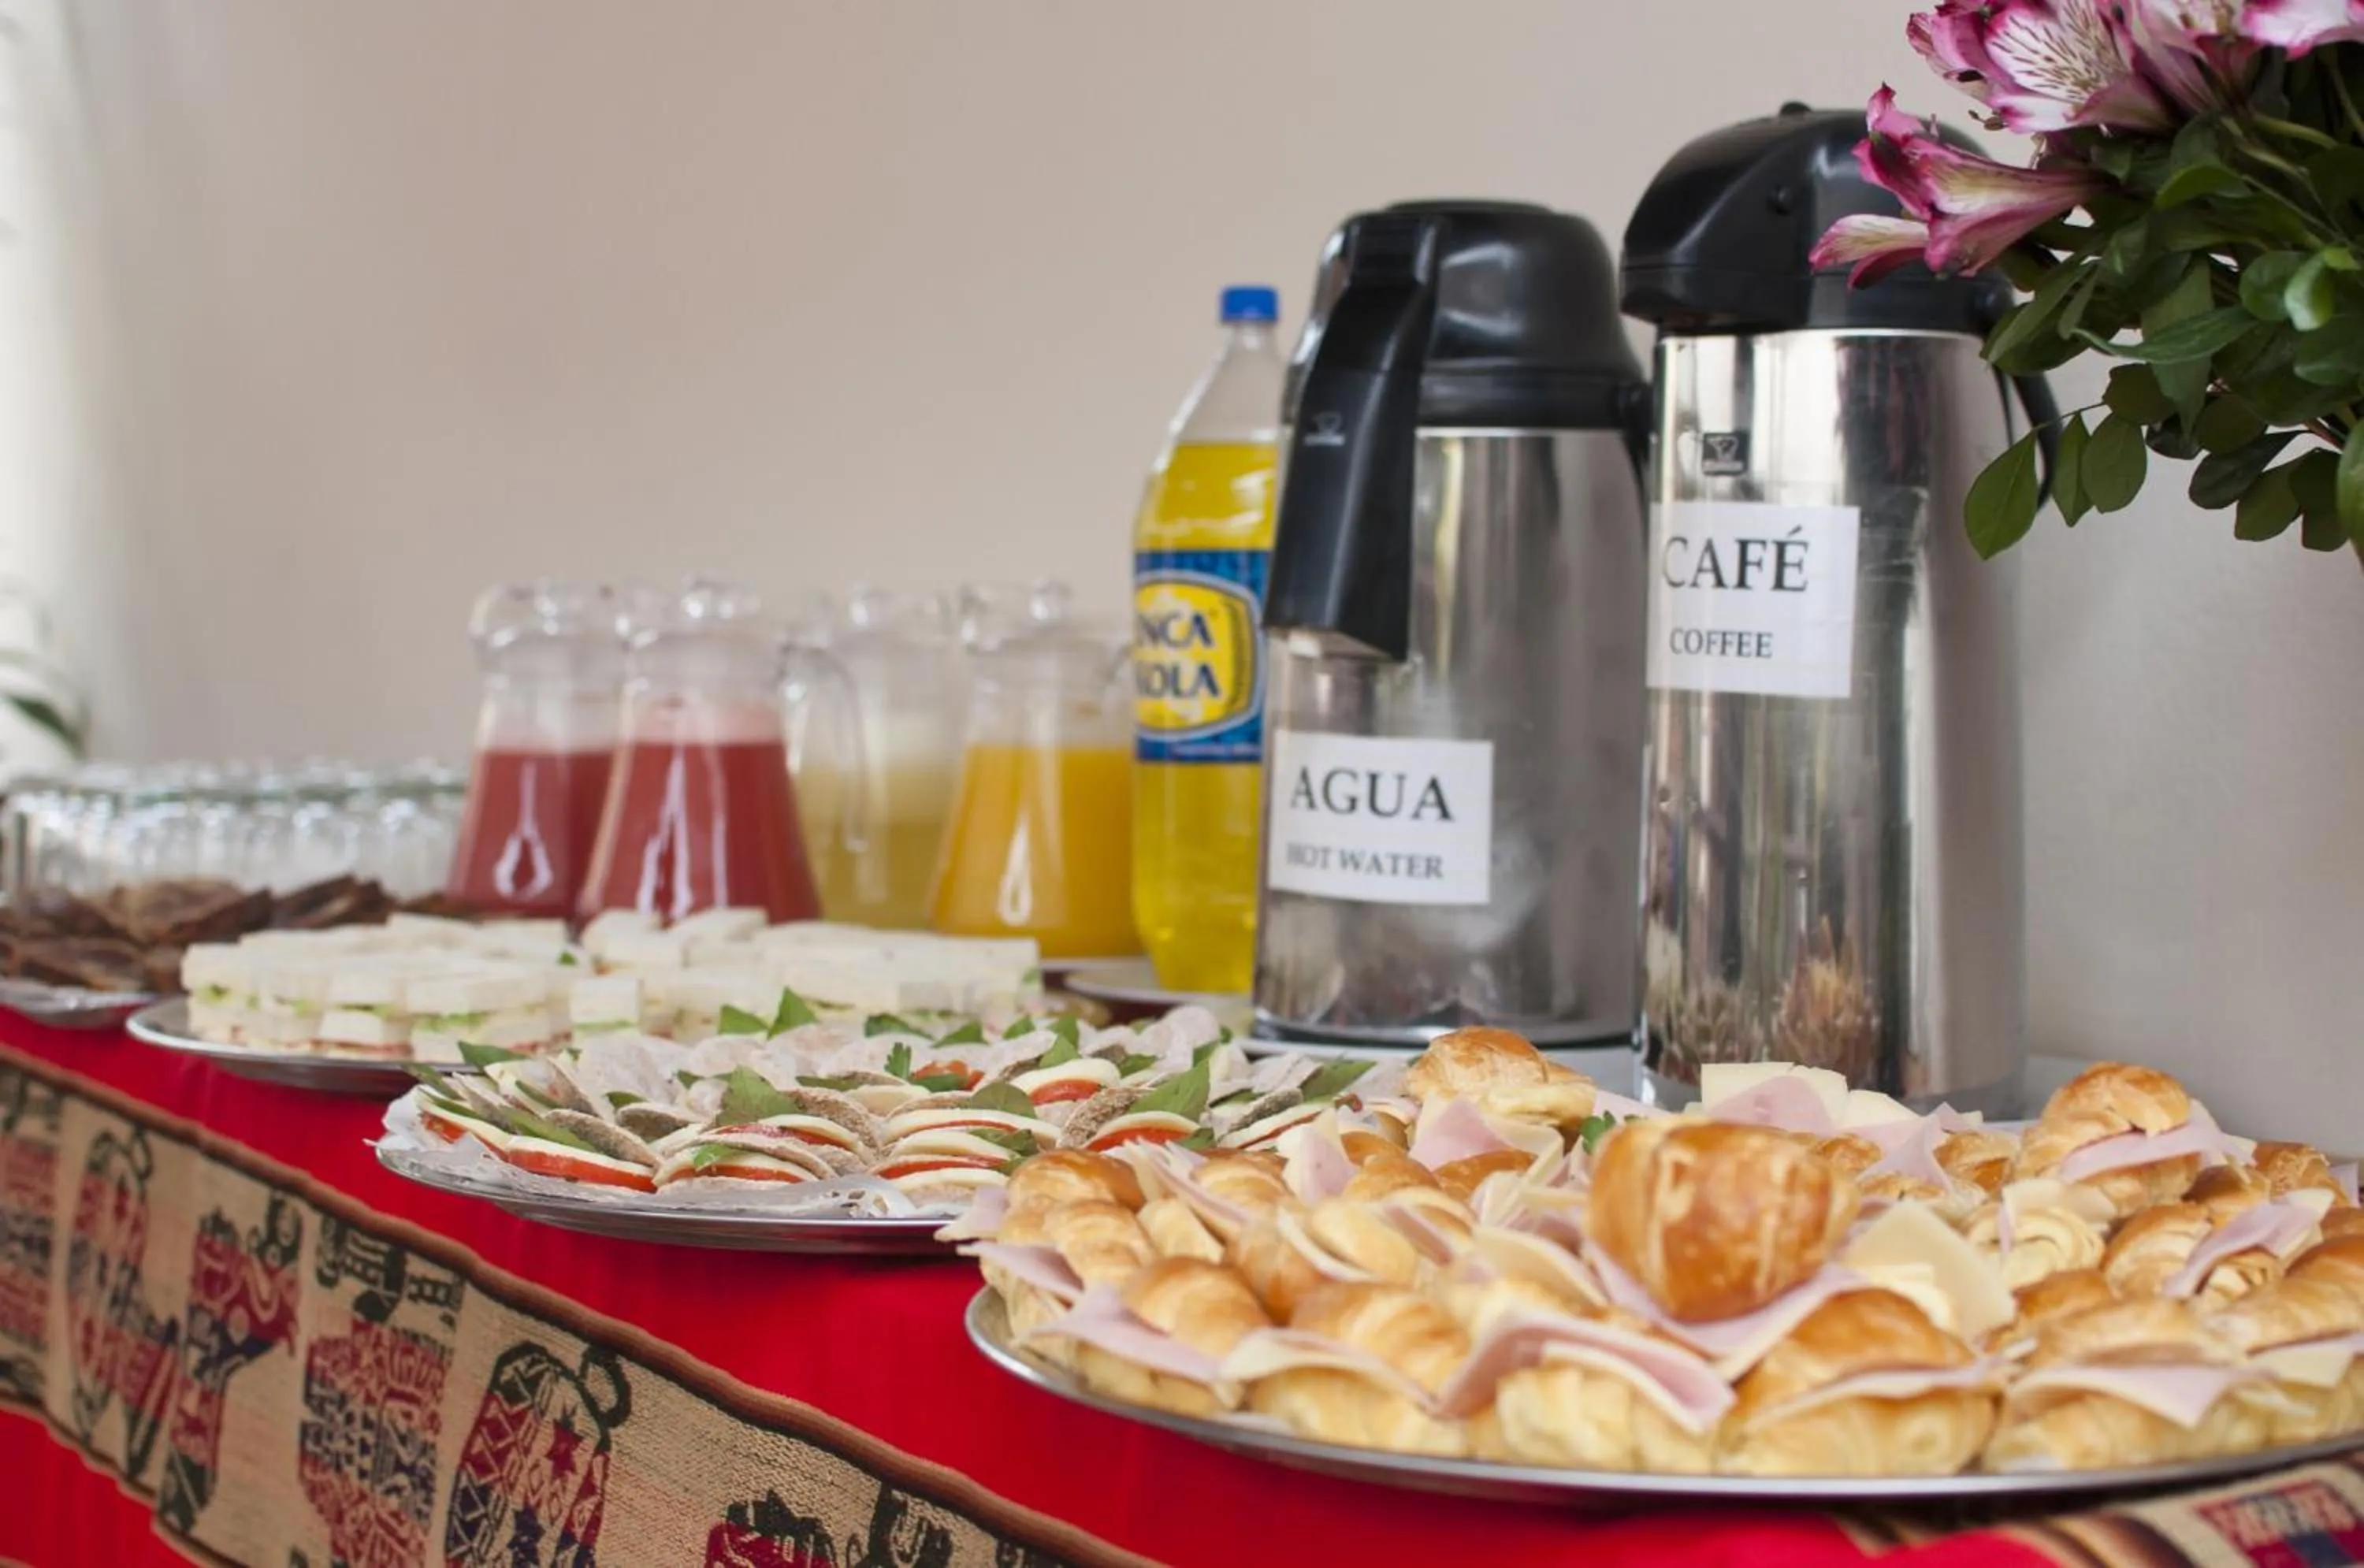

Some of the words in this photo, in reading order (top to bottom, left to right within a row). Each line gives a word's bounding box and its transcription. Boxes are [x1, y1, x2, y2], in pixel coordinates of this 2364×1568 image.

[1663, 525, 1809, 592] CAFÉ
[1135, 609, 1214, 648] NCA
[1669, 627, 1774, 659] COFFEE
[1290, 765, 1455, 823] AGUA
[1286, 842, 1332, 870] HOT
[1339, 847, 1444, 879] WATER
